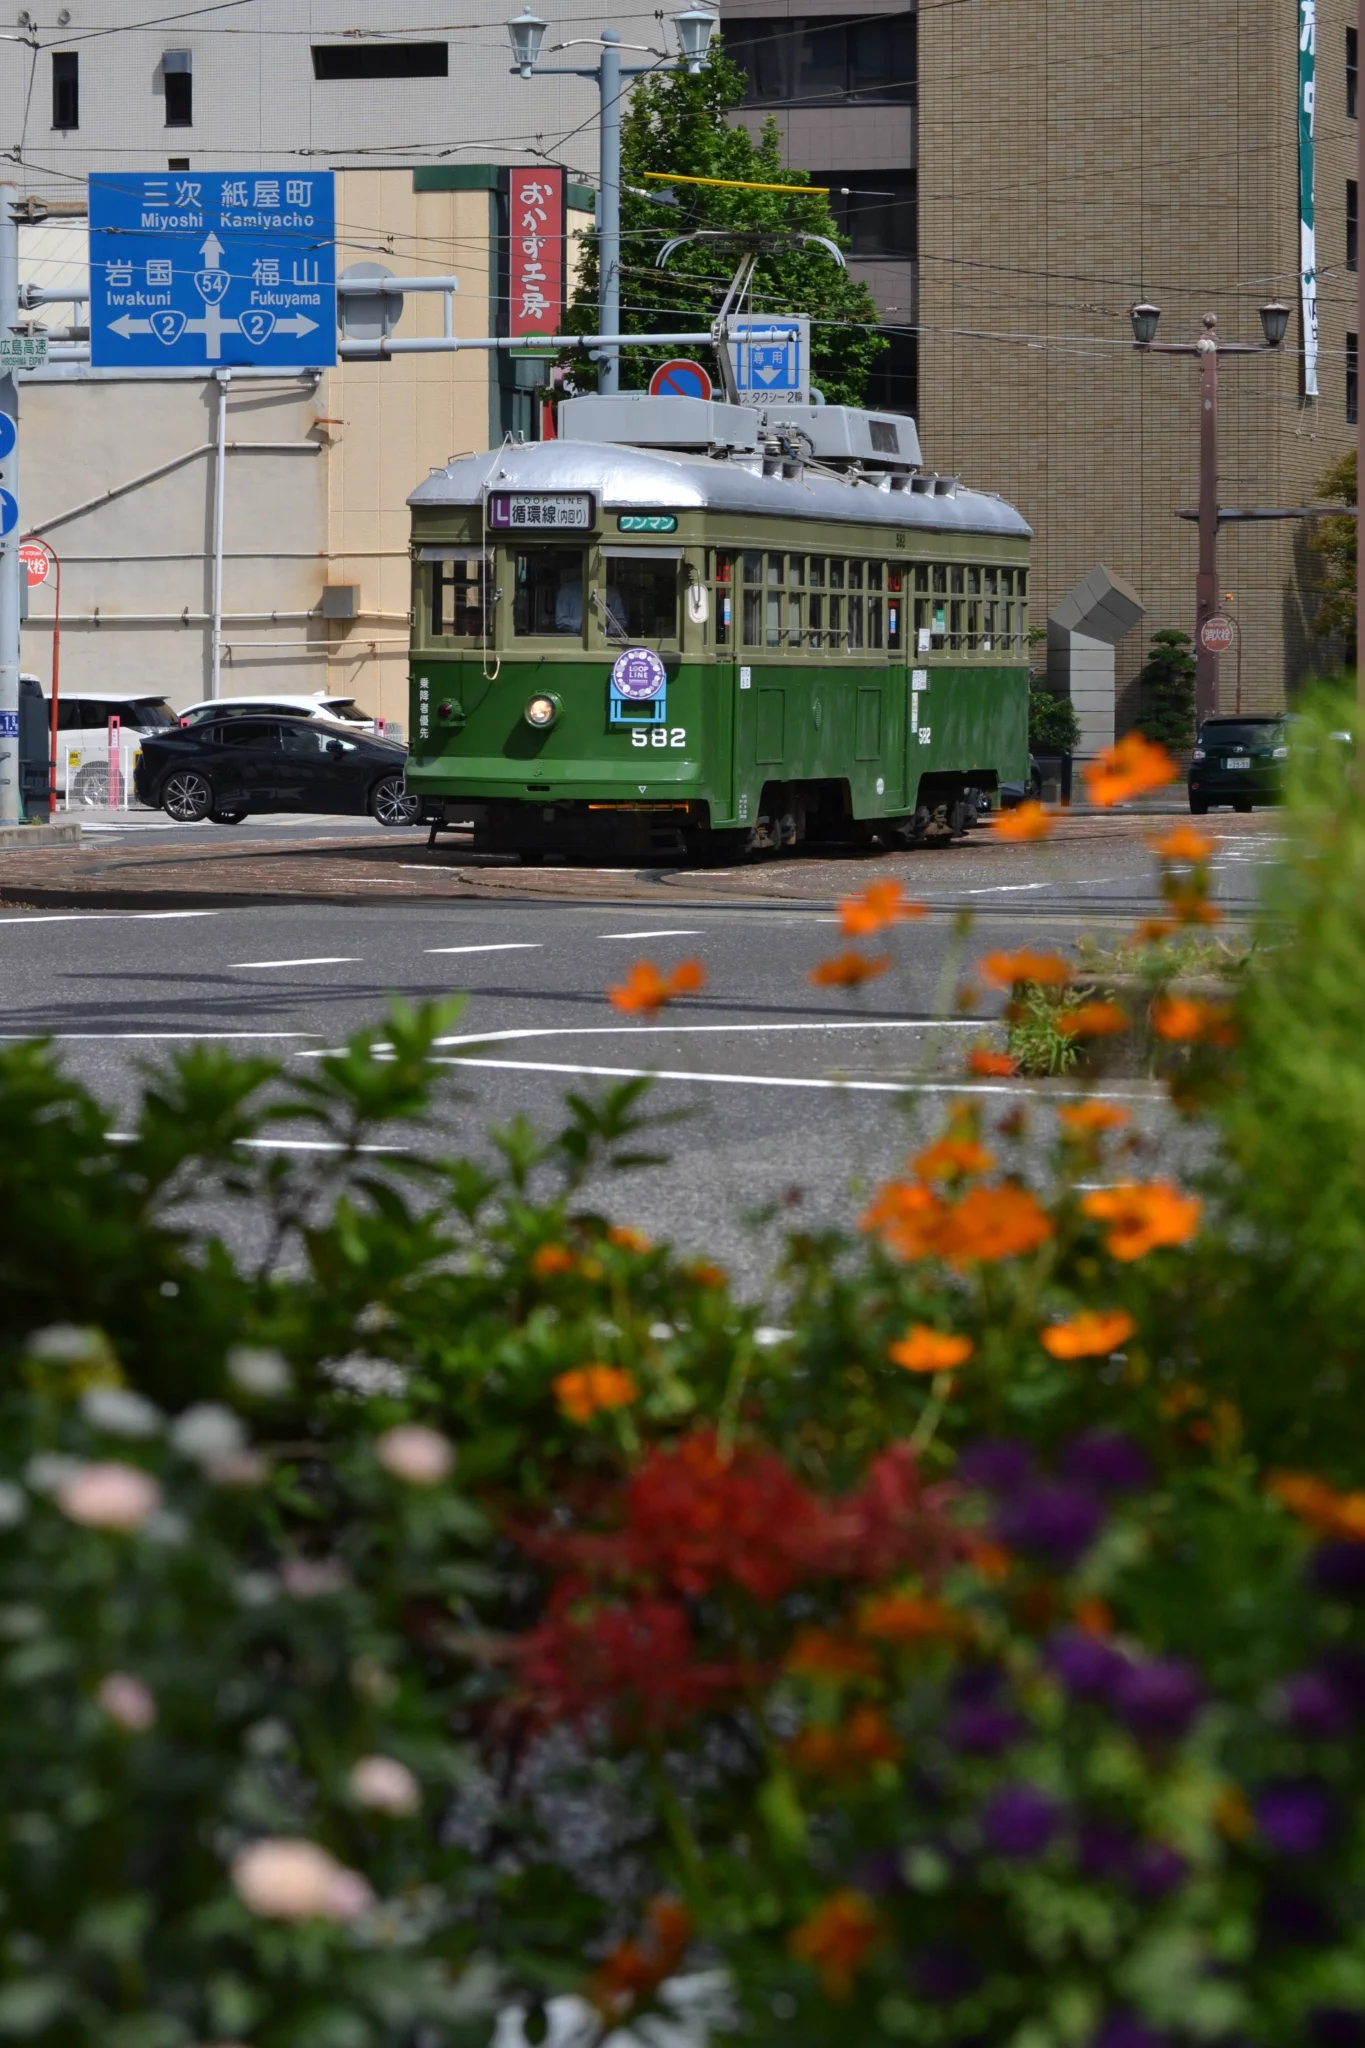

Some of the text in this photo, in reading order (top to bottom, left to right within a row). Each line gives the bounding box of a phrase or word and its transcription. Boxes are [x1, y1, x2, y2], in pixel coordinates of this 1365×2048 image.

[142, 180, 313, 208] 三次 紙屋町
[141, 212, 314, 230] Miyoshi Kamiyacho
[519, 182, 553, 319] おかず工房
[104, 258, 318, 287] 岩国 福山
[202, 276, 223, 293] 54
[106, 290, 321, 308] Iwakuni Fukuyama
[162, 316, 264, 335] 2 2
[1, 339, 46, 355] 広島高速
[754, 352, 782, 364] 専用
[752, 391, 785, 404] タクシー
[516, 496, 583, 505] LOOP LINE
[497, 499, 509, 521] L
[621, 516, 675, 529] ワンマン
[631, 728, 686, 747] 582
[919, 728, 931, 744] 582
